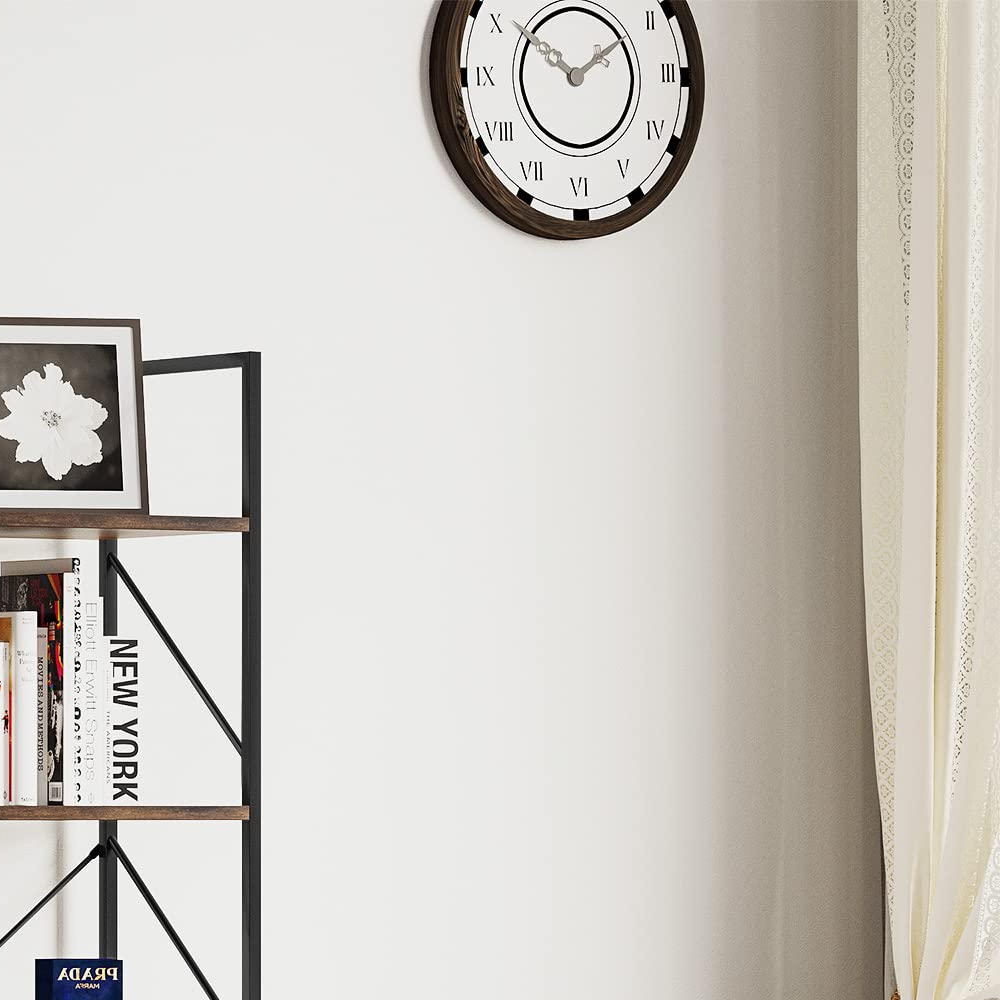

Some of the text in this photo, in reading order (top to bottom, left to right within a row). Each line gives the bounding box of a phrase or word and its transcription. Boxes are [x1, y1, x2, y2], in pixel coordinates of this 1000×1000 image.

[489, 13, 503, 33] X
[646, 11, 655, 30] II
[476, 66, 495, 86] IX
[661, 63, 675, 83] III
[485, 121, 513, 141] VIII
[647, 120, 665, 140] IV
[520, 161, 543, 181] VII
[617, 159, 629, 179] V
[569, 177, 588, 197] VI
[84, 602, 98, 781] Elliott Erwitt Snaps
[36, 656, 44, 773] MOVIES AND METHODS
[110, 639, 139, 801] NEW YORK
